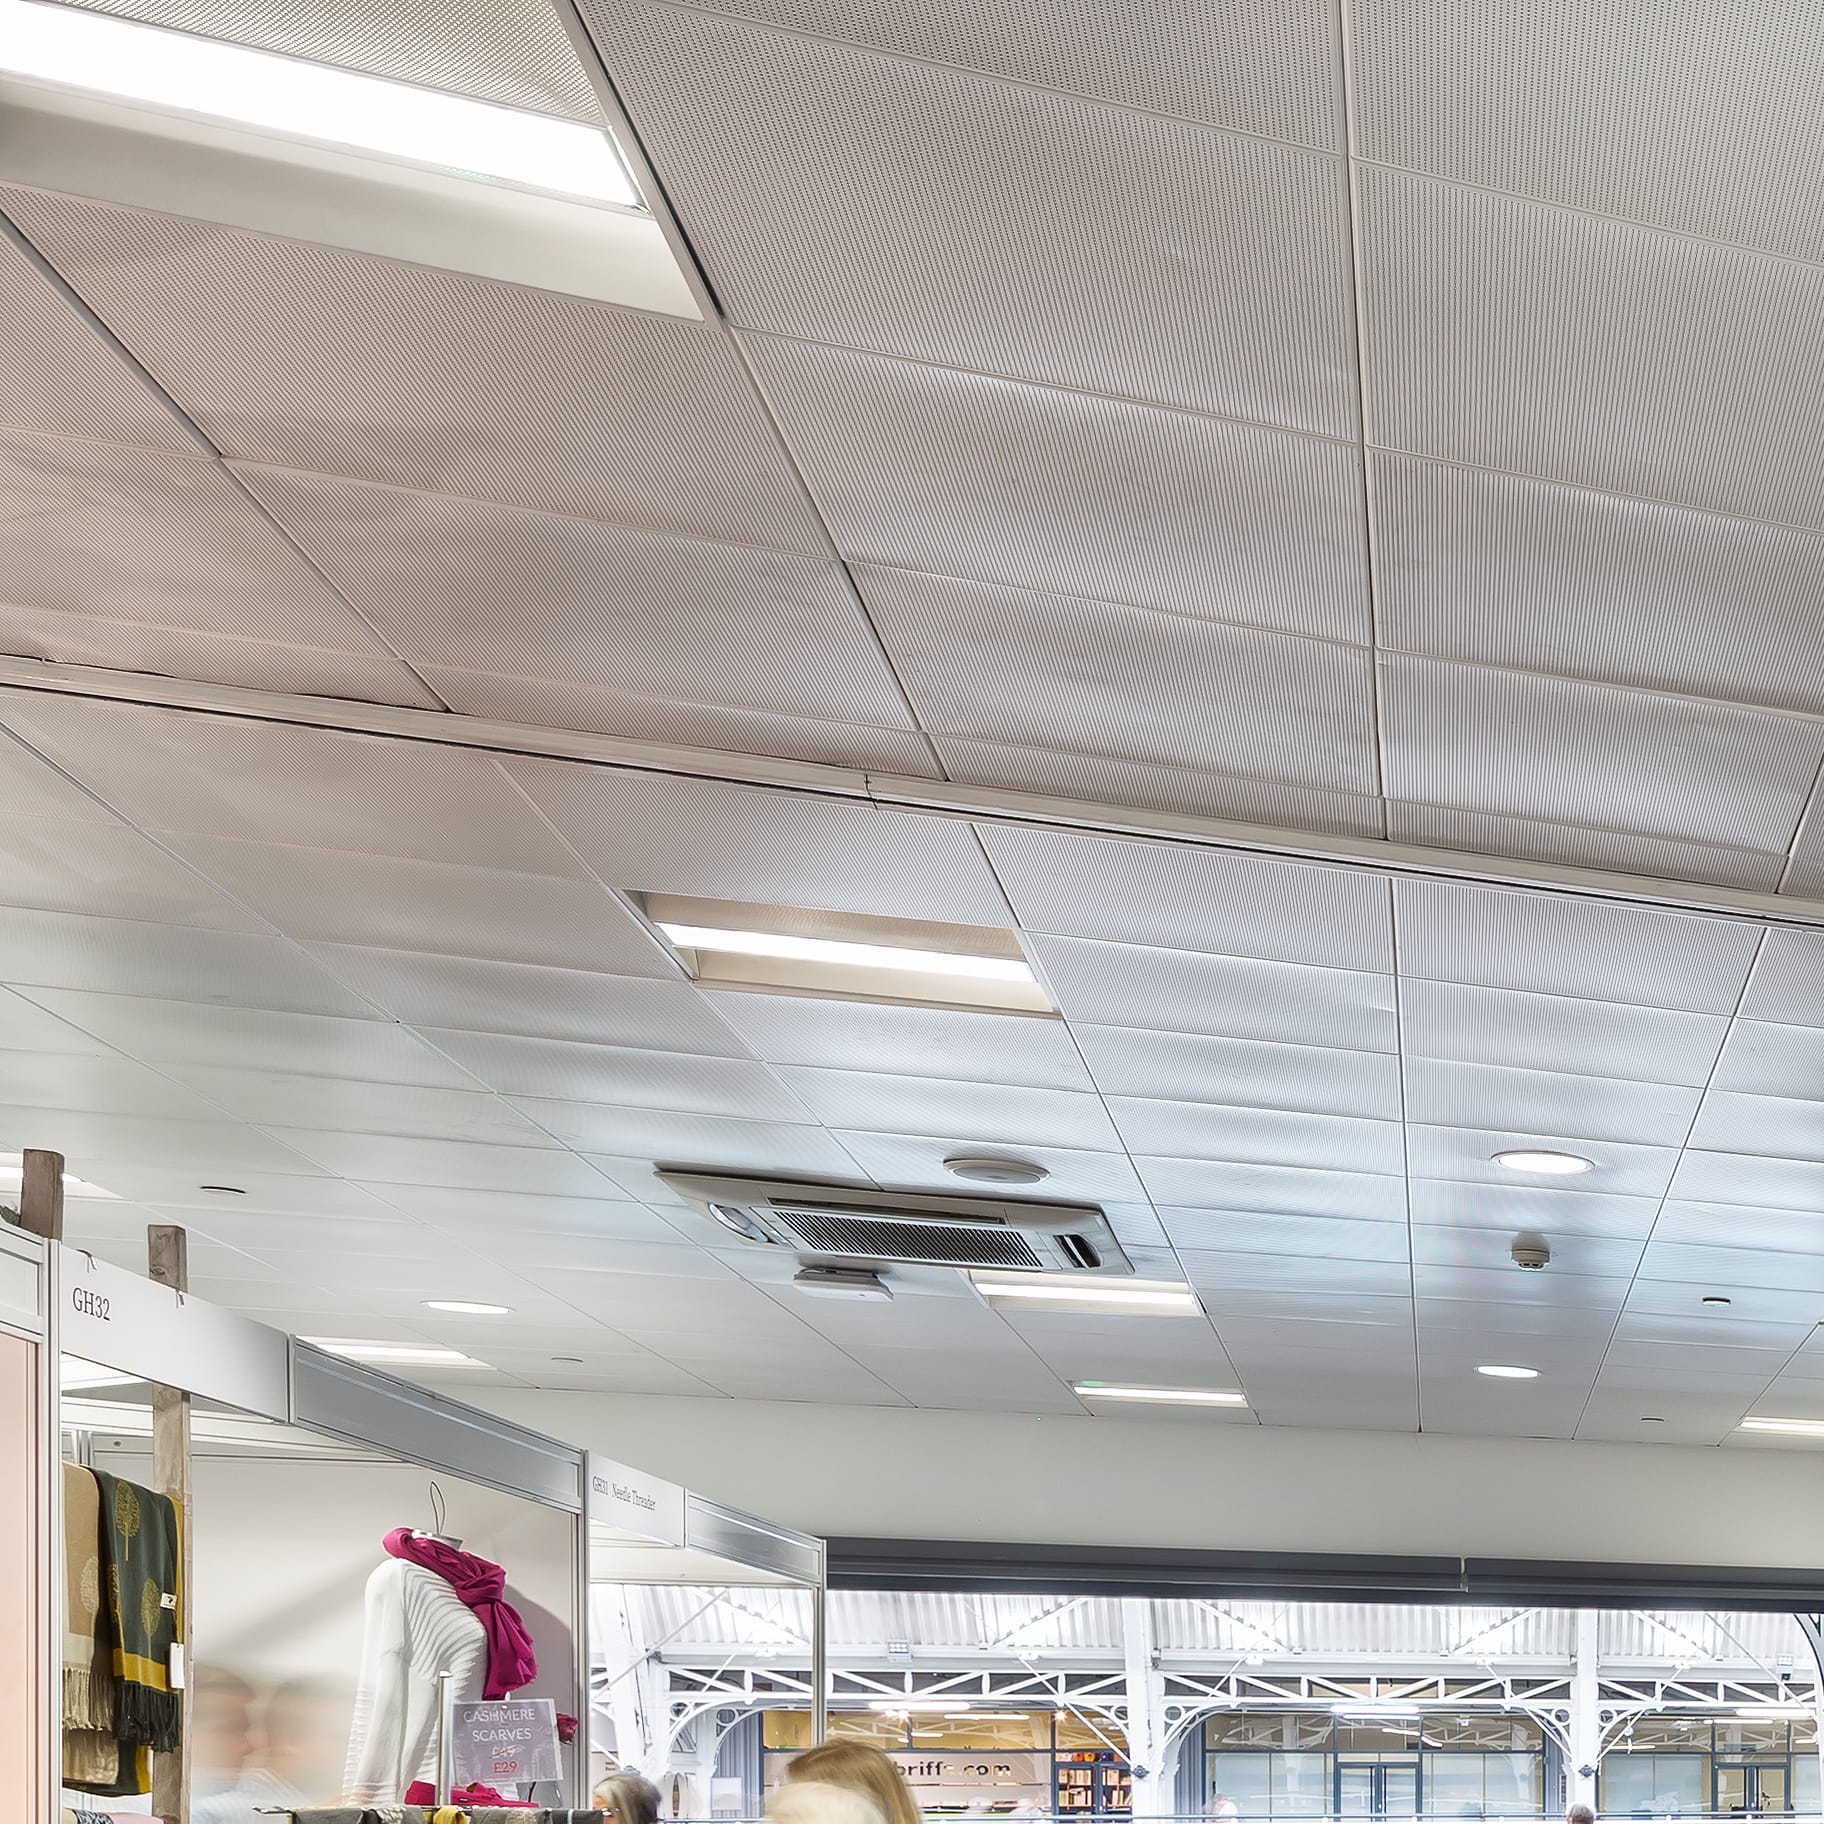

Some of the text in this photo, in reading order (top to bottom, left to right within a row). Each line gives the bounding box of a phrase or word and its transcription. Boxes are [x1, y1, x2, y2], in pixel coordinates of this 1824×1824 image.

[73, 1287, 110, 1321] GH32
[463, 1708, 536, 1723] CASHMERE
[472, 1727, 532, 1742] SCARVES
[493, 1761, 518, 1774] £29
